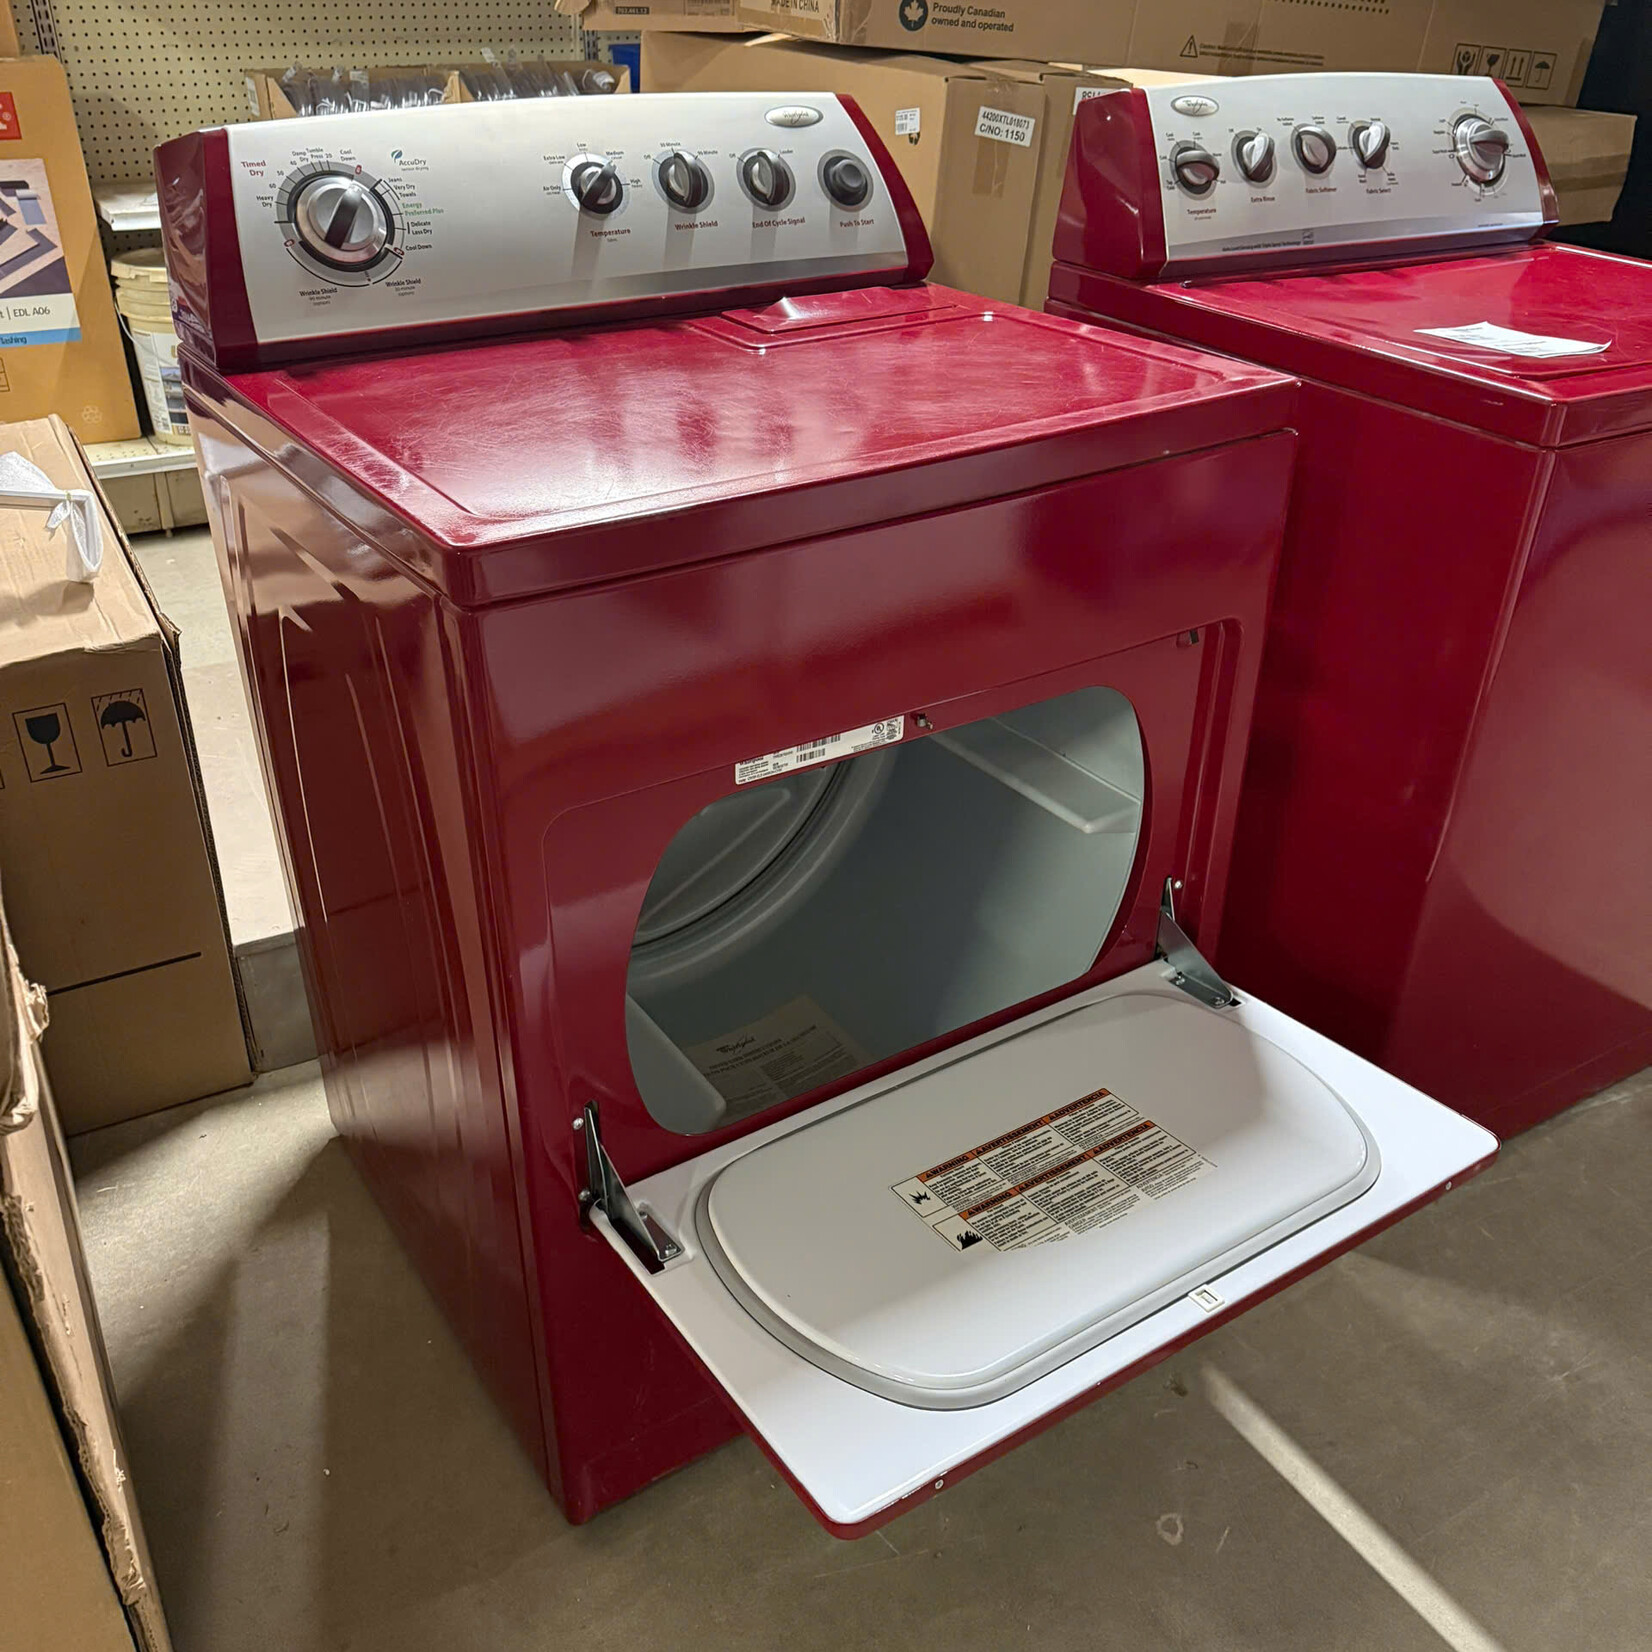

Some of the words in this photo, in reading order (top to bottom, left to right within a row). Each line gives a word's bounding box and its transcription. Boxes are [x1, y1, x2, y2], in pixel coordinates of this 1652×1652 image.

[800, 0, 820, 13] CHINA
[933, 2, 966, 16] Proudly
[967, 6, 1006, 18] Canadian
[932, 16, 960, 26] owned
[961, 18, 976, 28] and
[978, 20, 1014, 32] operated
[979, 123, 1004, 138] C/NO:
[1005, 129, 1026, 142] 1150
[241, 160, 266, 169] Timed
[399, 158, 427, 166] AccuDry
[249, 169, 264, 177] Dry
[549, 184, 562, 192] Only
[1318, 186, 1337, 194] Softener
[404, 209, 432, 217] Preferred
[1187, 207, 1217, 216] Temperature
[411, 220, 431, 228] Delicate
[674, 222, 699, 231] Wrinkle
[698, 220, 719, 229] Shield
[752, 220, 764, 229] End
[764, 219, 772, 228] Of
[772, 217, 787, 228] Cycle
[787, 216, 806, 227] Signal
[839, 220, 854, 228] Push
[853, 219, 860, 227] To
[860, 218, 875, 227] Start
[590, 227, 631, 238] Temperature
[385, 279, 405, 288] Wrinkle
[405, 277, 422, 286] Shield
[299, 289, 320, 297] Wrinkle
[320, 287, 338, 295] Shield
[13, 308, 31, 317] EDL
[930, 1155, 970, 1177] WARNING
[981, 1119, 1043, 1153] AVERTISSEMENT
[1053, 1090, 1105, 1119] ADVERTENCIA
[972, 1191, 1013, 1213] WARNING
[1023, 1153, 1087, 1190] AVERTISSEMENT
[1098, 1123, 1151, 1152] ADVERTENCIA
